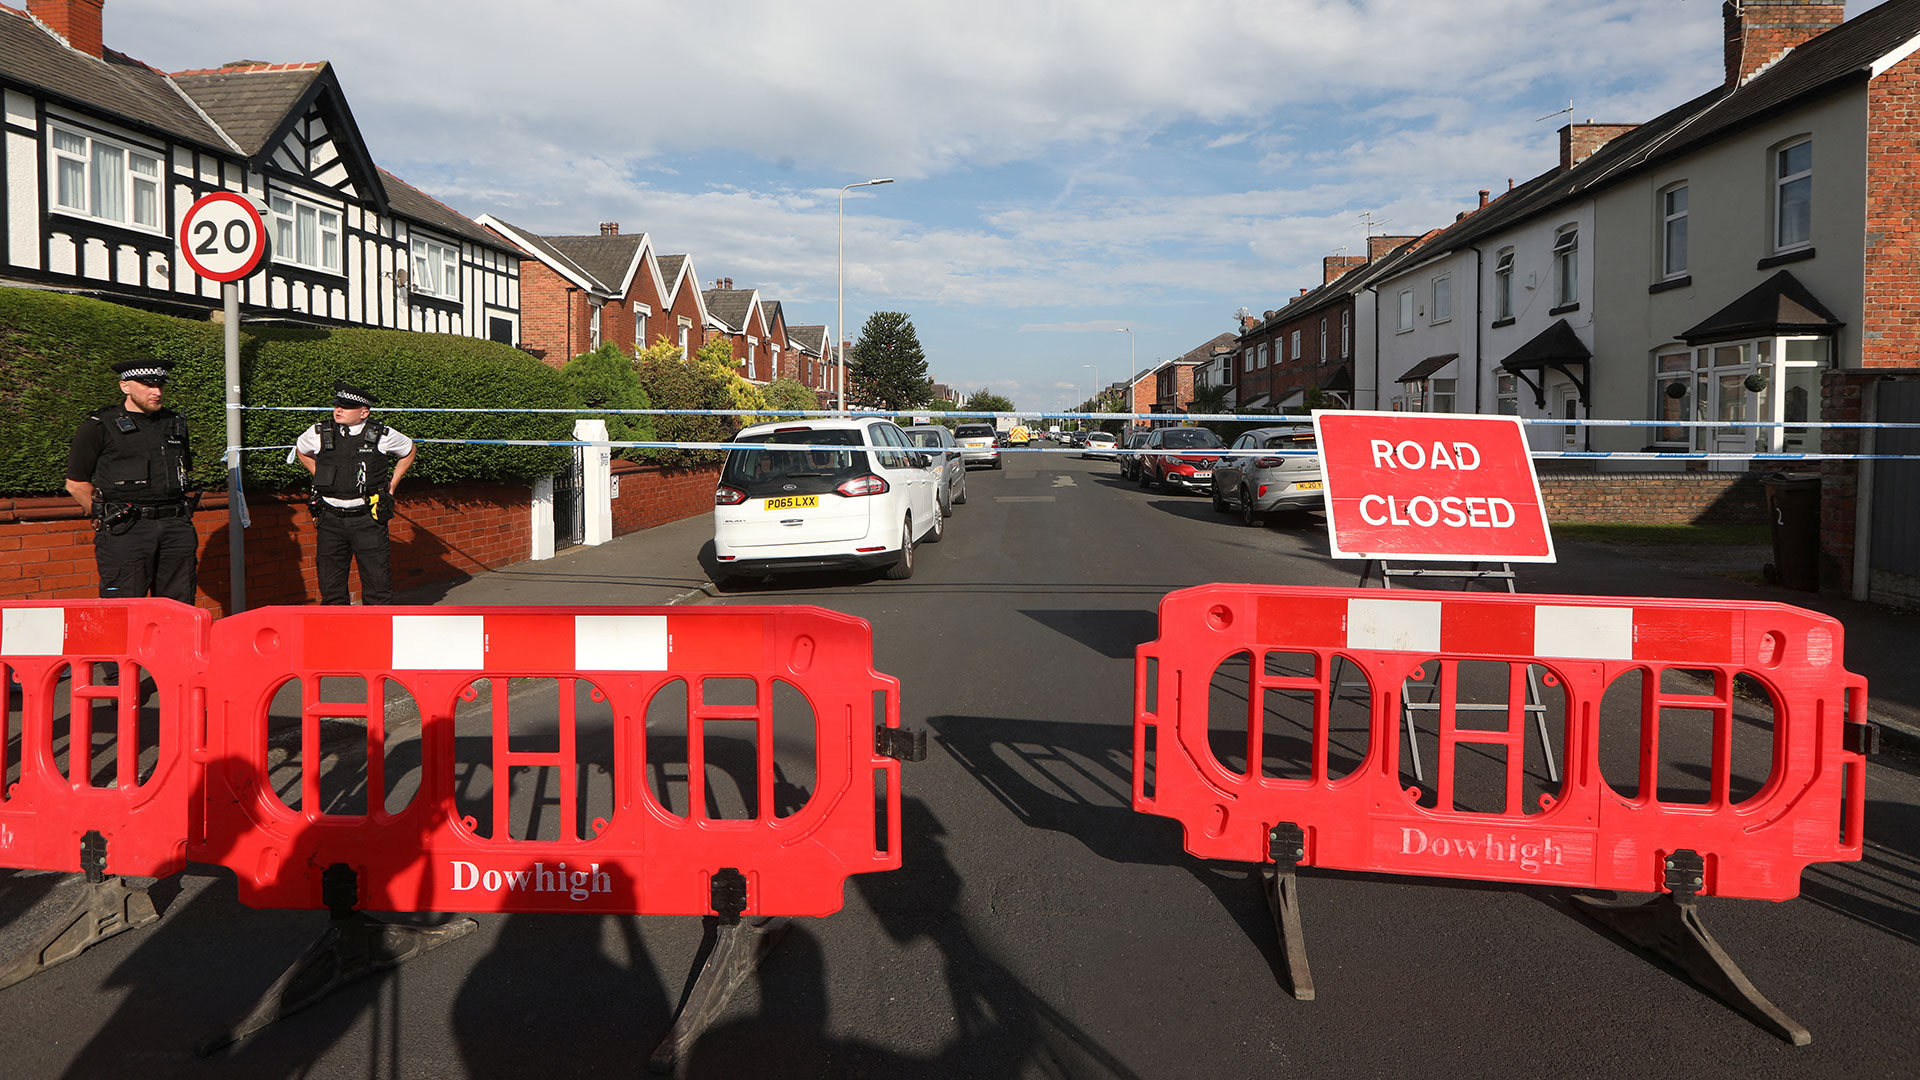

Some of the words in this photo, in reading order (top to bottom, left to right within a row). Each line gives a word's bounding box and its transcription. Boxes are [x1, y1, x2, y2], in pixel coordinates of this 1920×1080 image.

[194, 219, 250, 254] 20
[1370, 439, 1481, 471] ROAD
[768, 497, 793, 509] PO65
[795, 496, 815, 507] LXX
[1359, 494, 1516, 528] CLOSED
[1399, 826, 1564, 874] Dowhigh
[450, 860, 613, 901] Dowhigh
